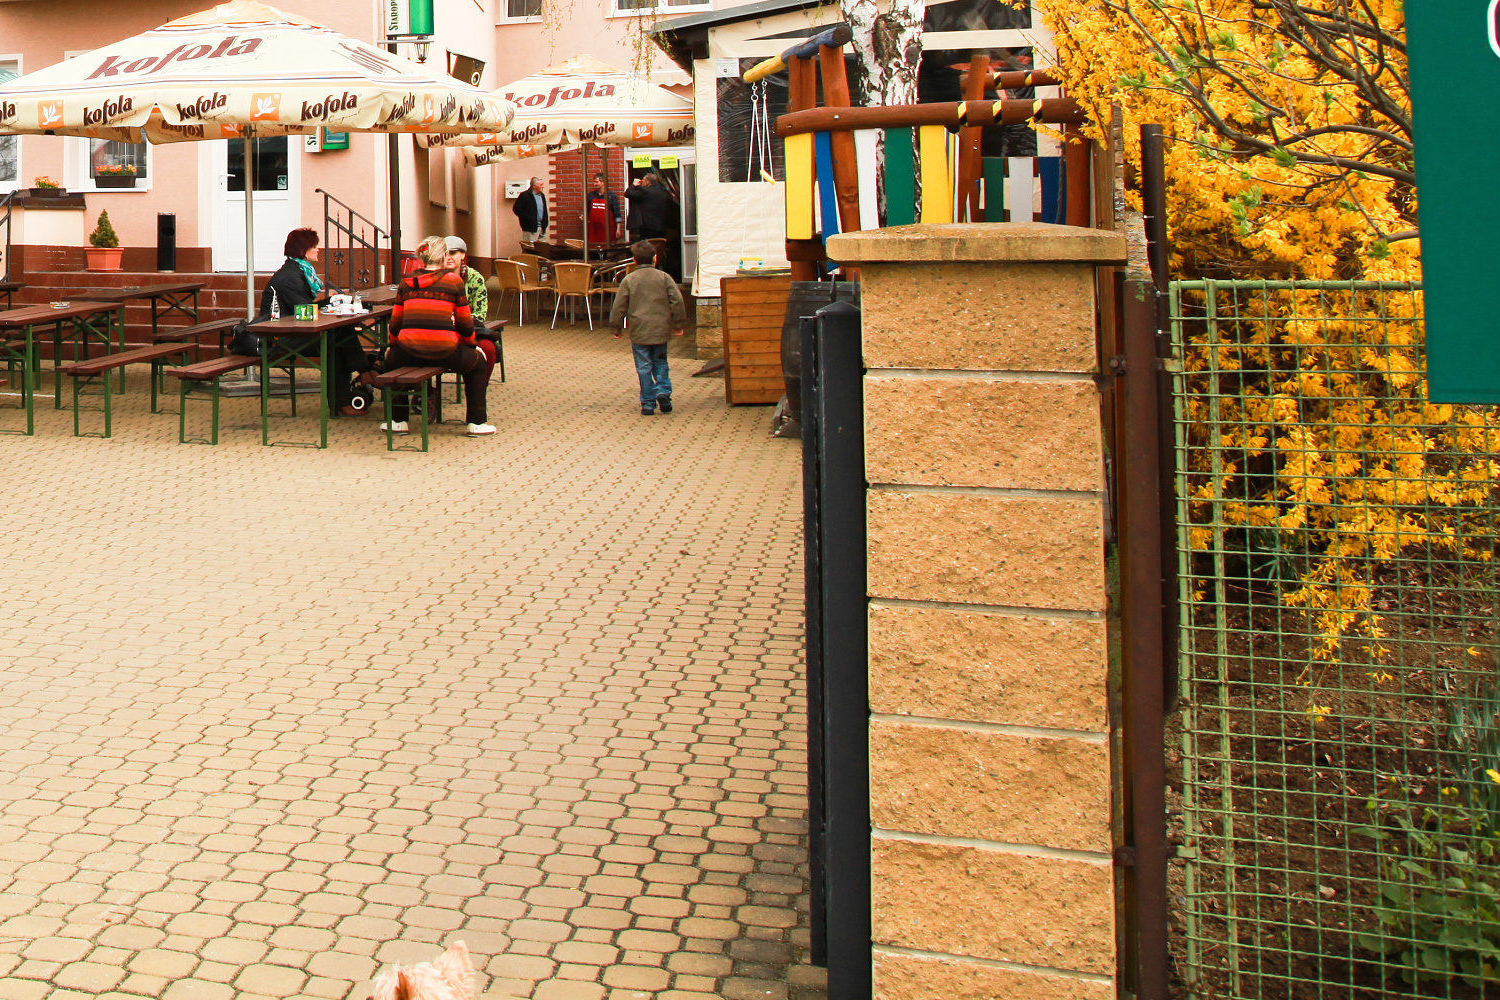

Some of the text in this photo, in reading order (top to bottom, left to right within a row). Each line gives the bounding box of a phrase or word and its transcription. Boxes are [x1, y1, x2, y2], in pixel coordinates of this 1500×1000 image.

[84, 35, 263, 80] kofola
[176, 92, 228, 122] kofola
[300, 91, 358, 122] kofola
[505, 81, 615, 109] kofola
[83, 95, 133, 127] kofola
[511, 122, 547, 143] kofola
[579, 122, 615, 141] kofola
[474, 145, 504, 166] kofola
